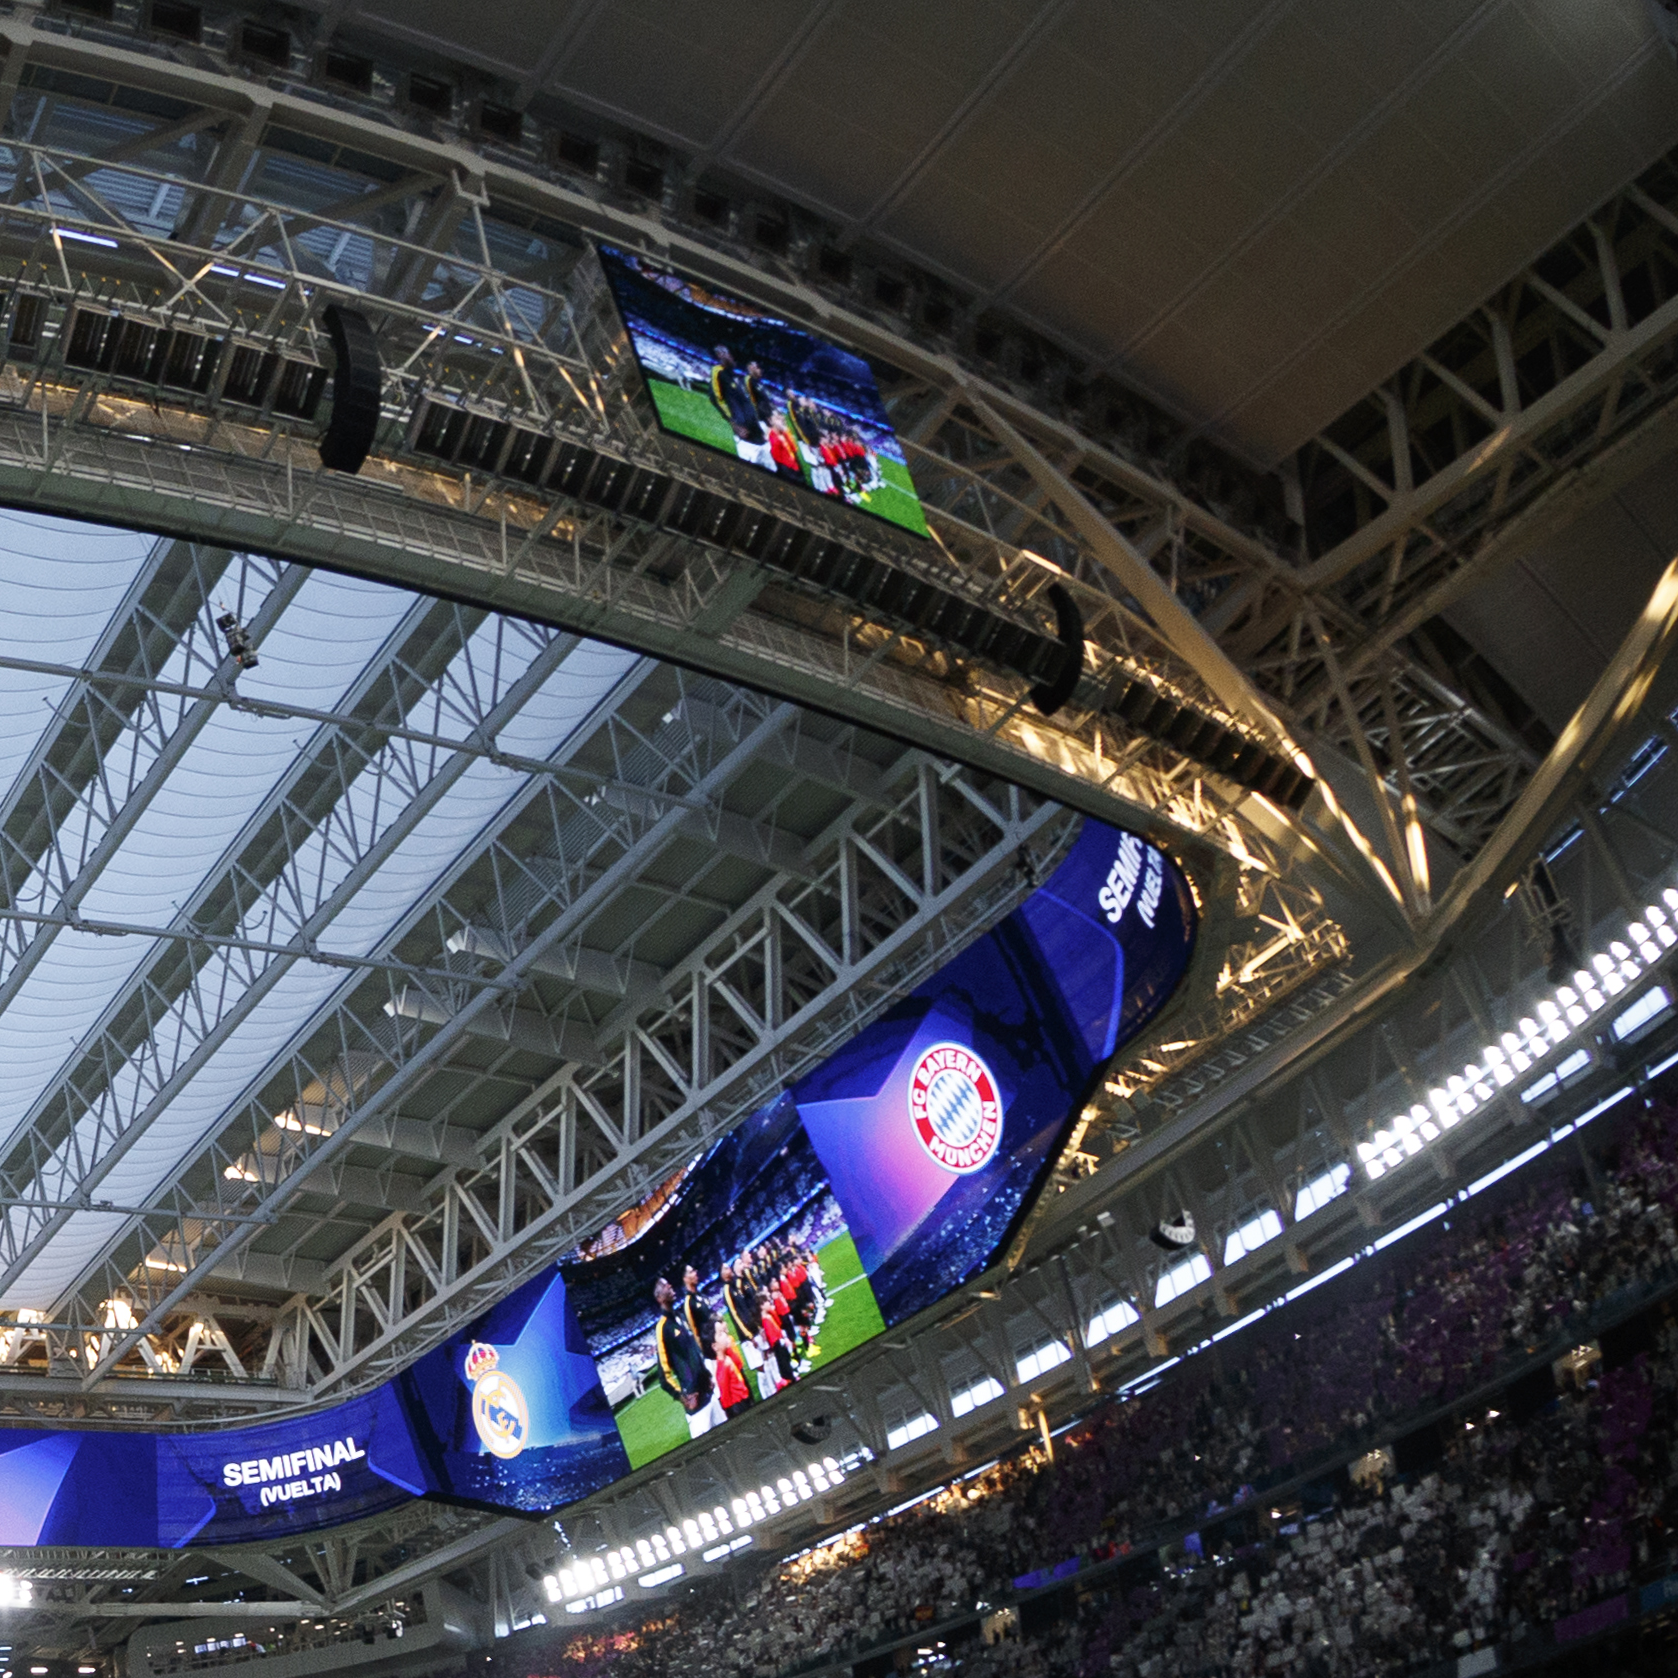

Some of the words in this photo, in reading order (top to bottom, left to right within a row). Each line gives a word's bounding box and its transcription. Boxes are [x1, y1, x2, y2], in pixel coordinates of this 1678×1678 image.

[917, 1050, 982, 1086] BAYERN
[913, 1088, 927, 1119] FC
[223, 1437, 365, 1487] SEMIFINAL
[260, 1471, 341, 1507] (VUELTA)
